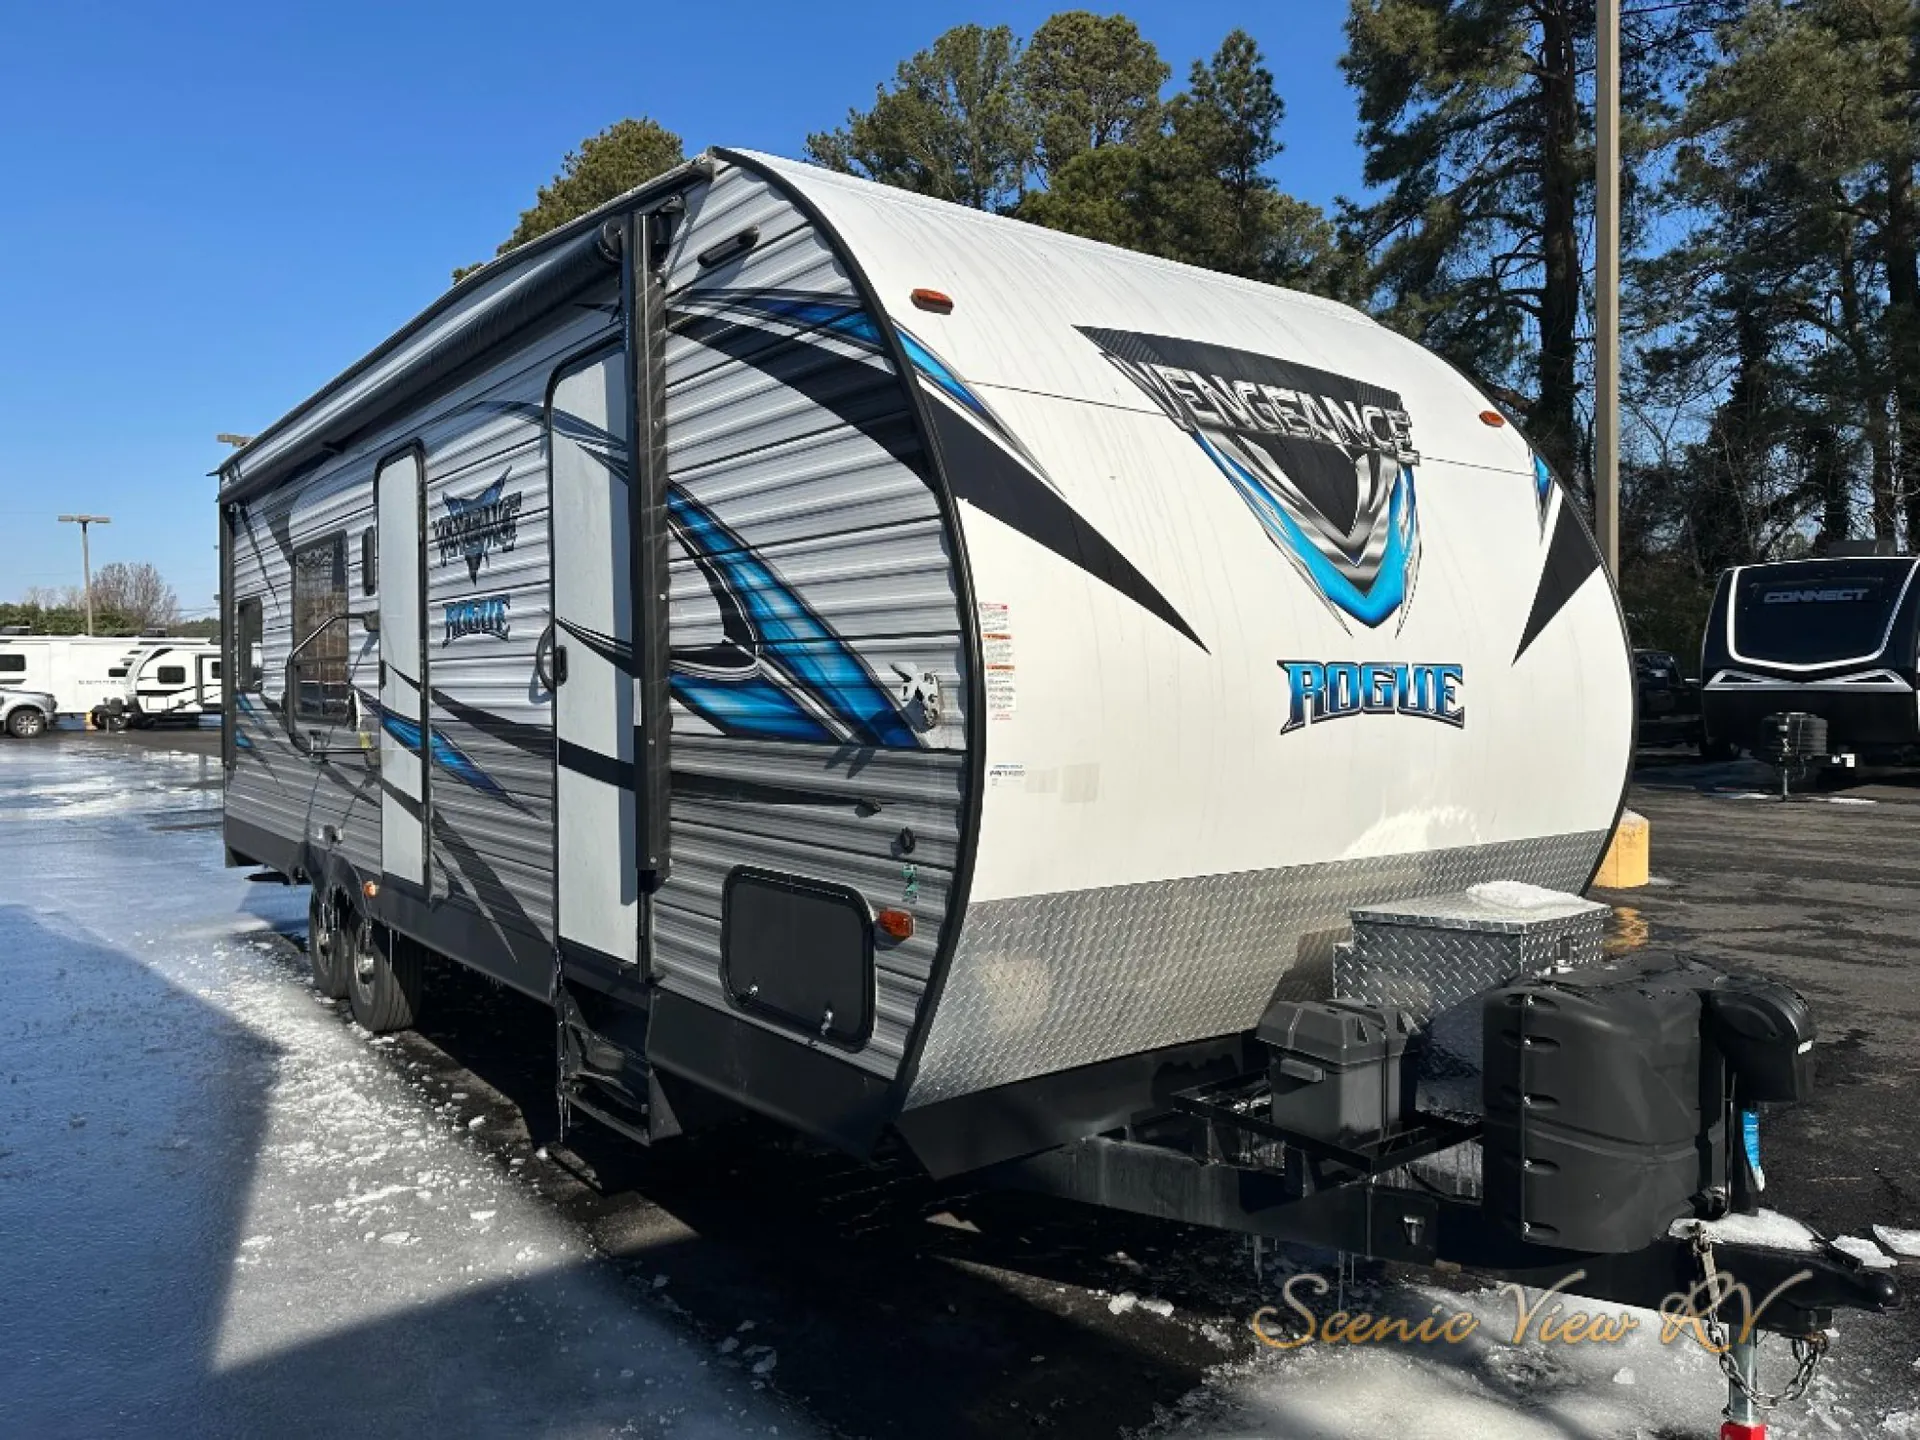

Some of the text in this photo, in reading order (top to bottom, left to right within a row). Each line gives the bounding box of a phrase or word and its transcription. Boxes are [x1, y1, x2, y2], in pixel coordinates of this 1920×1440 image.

[1101, 356, 1420, 467] VENGEANCE
[1764, 588, 1869, 603] CONNECT
[1277, 660, 1464, 734] ROGUE
